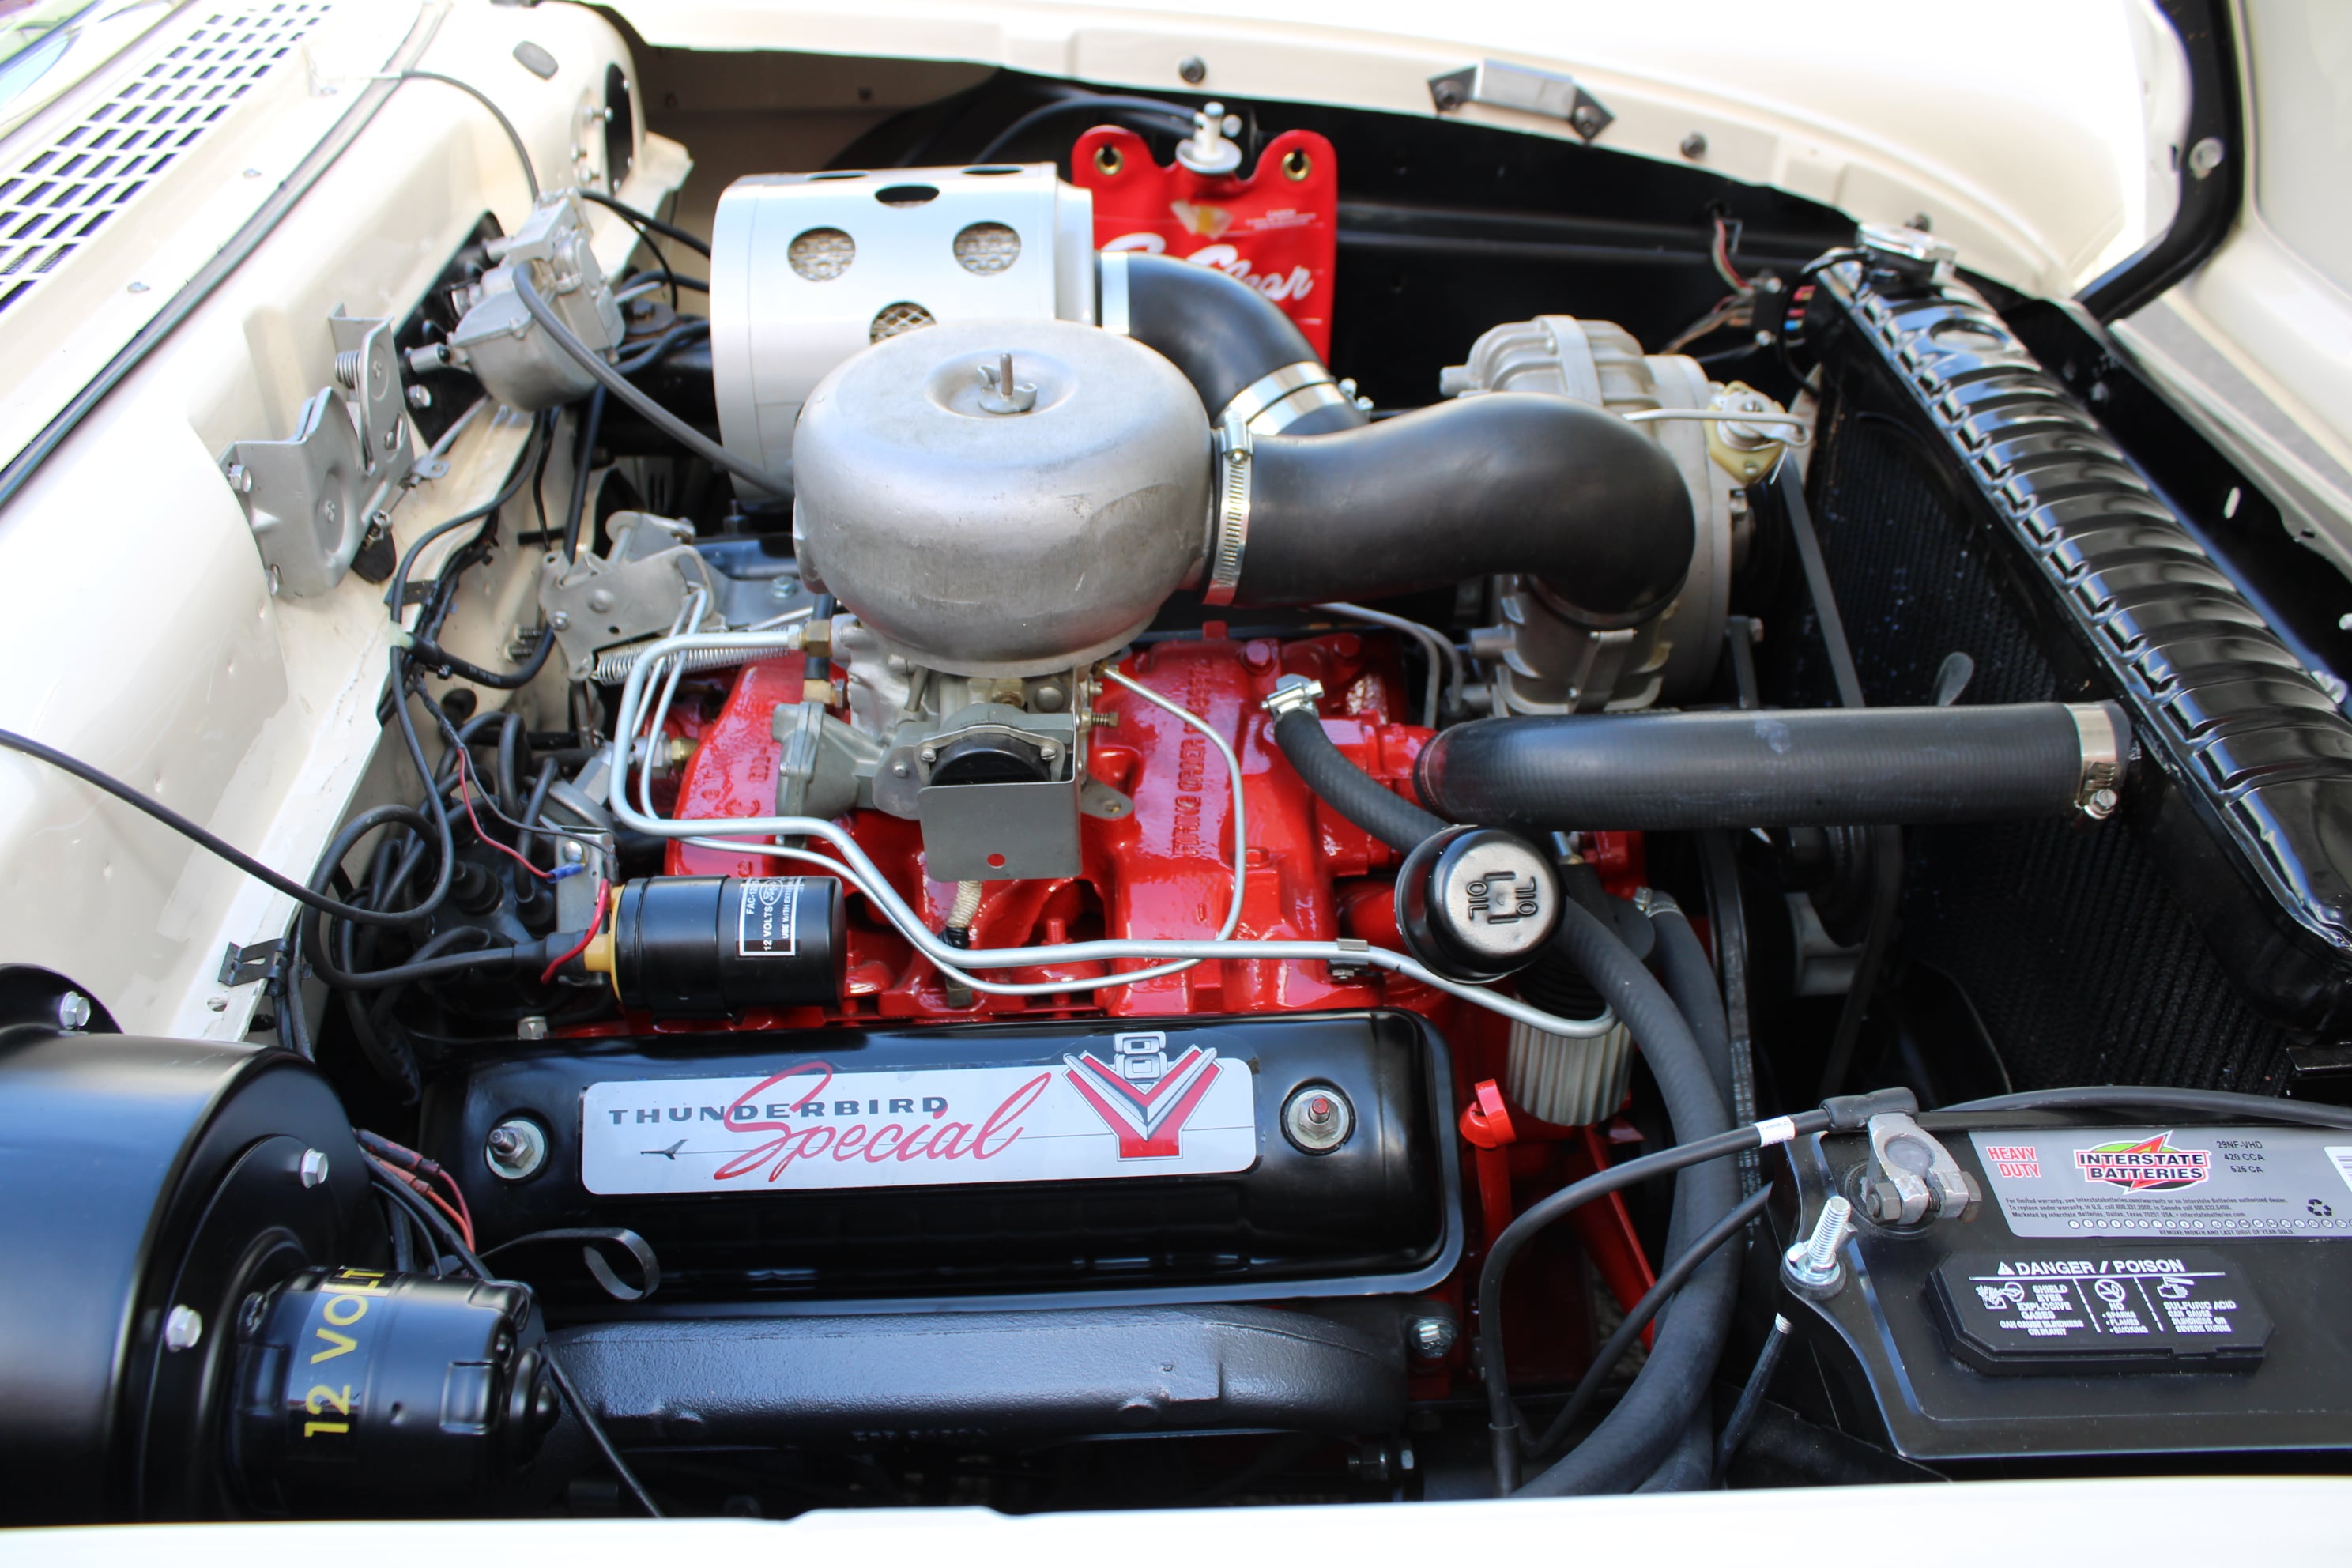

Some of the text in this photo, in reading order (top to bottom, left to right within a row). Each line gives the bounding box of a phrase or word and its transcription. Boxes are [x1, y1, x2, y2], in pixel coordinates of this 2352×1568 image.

[1466, 880, 1490, 921] OIL
[1514, 876, 1539, 917] OIL
[782, 904, 790, 922] WITH
[763, 906, 774, 937] VOLTS
[781, 924, 790, 938] USE
[763, 940, 773, 951] 12
[609, 1096, 948, 1125] THUNDERBIRD
[713, 1061, 1053, 1182] Special
[2216, 1140, 2263, 1149] 29NF-VHD
[1986, 1146, 2037, 1161] HEAVY
[2080, 1154, 2204, 1165] INTERSTATE
[1998, 1163, 2041, 1178] DUTY
[2090, 1167, 2203, 1179] BATTERIES
[2015, 1261, 2096, 1275] DANGER
[2112, 1259, 2185, 1273] POISON
[2032, 1284, 2068, 1294] SHIELD
[2016, 1302, 2073, 1311] EXPLOSIVE
[2163, 1300, 2237, 1310] SULFURIC ACID
[2021, 1310, 2056, 1320] GASES
[304, 1268, 386, 1438] 12 VOLT
